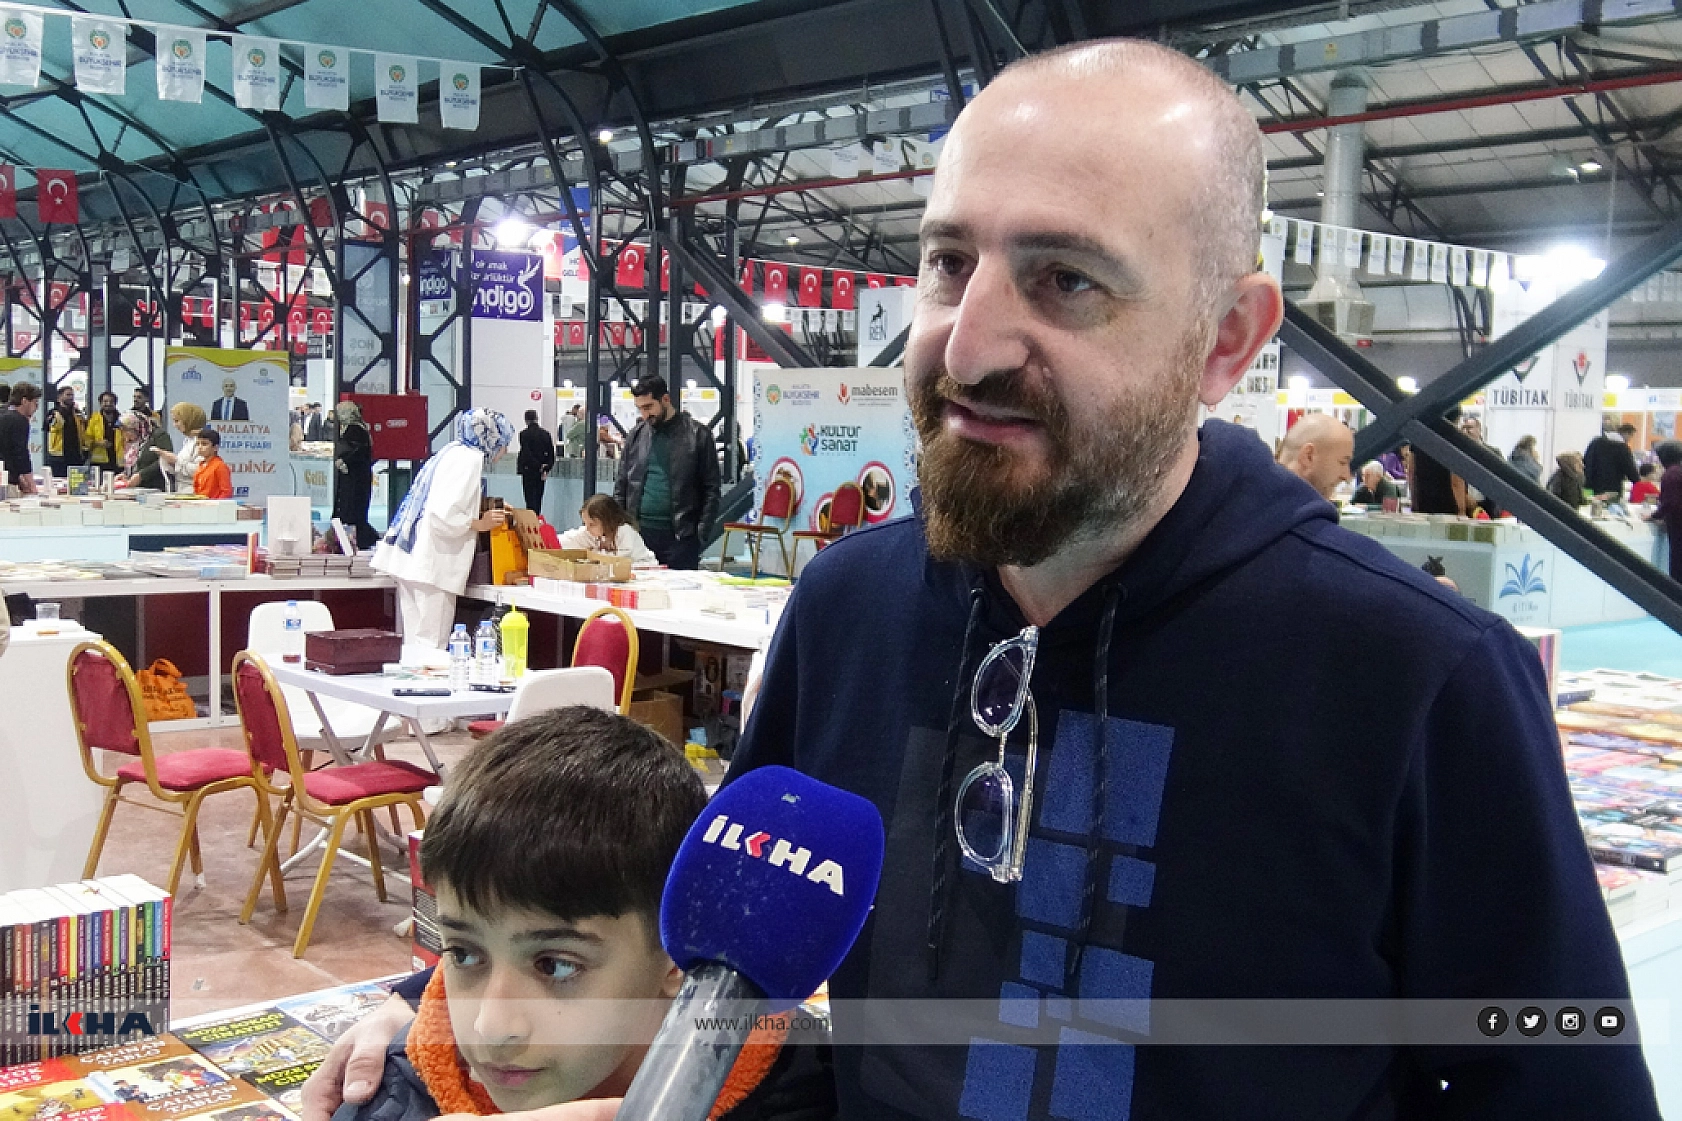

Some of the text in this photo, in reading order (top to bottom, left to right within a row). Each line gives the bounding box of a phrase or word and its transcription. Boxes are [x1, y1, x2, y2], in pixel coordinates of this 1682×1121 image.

[474, 284, 534, 316] ndigo
[1493, 385, 1549, 406] TÜBİTAK
[1563, 389, 1594, 409] TÜBİTAK
[216, 424, 271, 434] MALATYA
[702, 814, 844, 896] İLKHA
